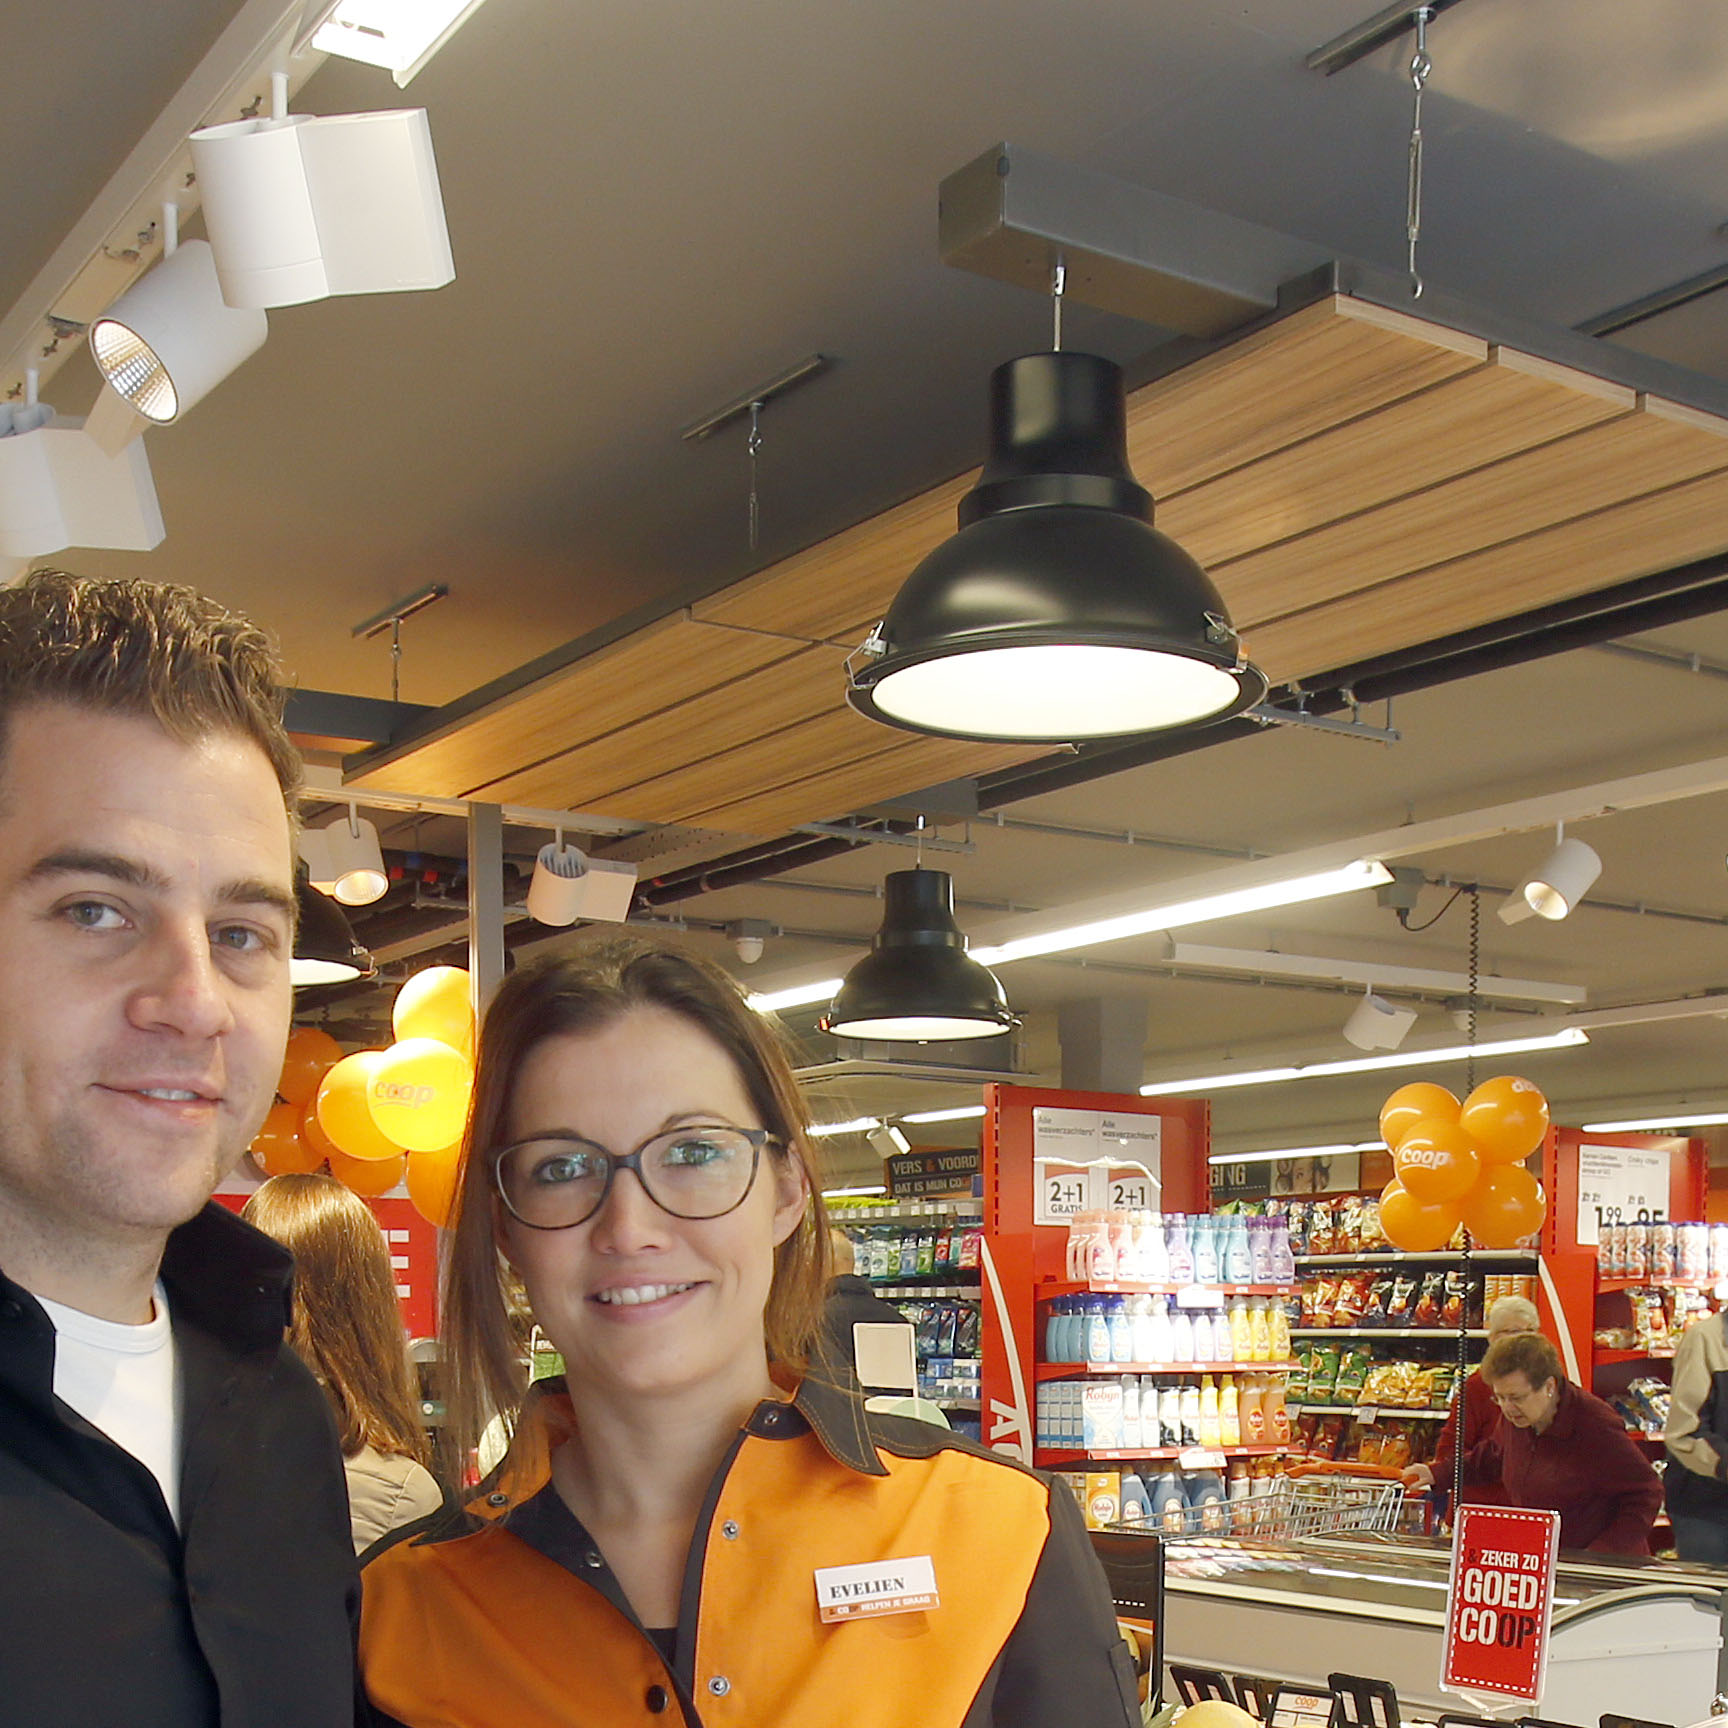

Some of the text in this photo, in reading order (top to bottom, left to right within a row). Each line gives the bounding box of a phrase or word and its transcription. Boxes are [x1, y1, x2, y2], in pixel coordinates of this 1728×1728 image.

[375, 1081, 436, 1109] coop
[892, 1159, 923, 1175] VERS
[1401, 1149, 1450, 1170] coop
[894, 1181, 910, 1194] DAT
[913, 1180, 924, 1192] IS
[1050, 1181, 1083, 1203] 2+1
[1113, 1184, 1145, 1206] 2+1
[1479, 1549, 1519, 1569] ZEKER
[1522, 1553, 1540, 1571] ZO
[829, 1576, 906, 1600] EVELIEN
[1463, 1567, 1539, 1610] GOED
[1459, 1607, 1537, 1650] COOP
